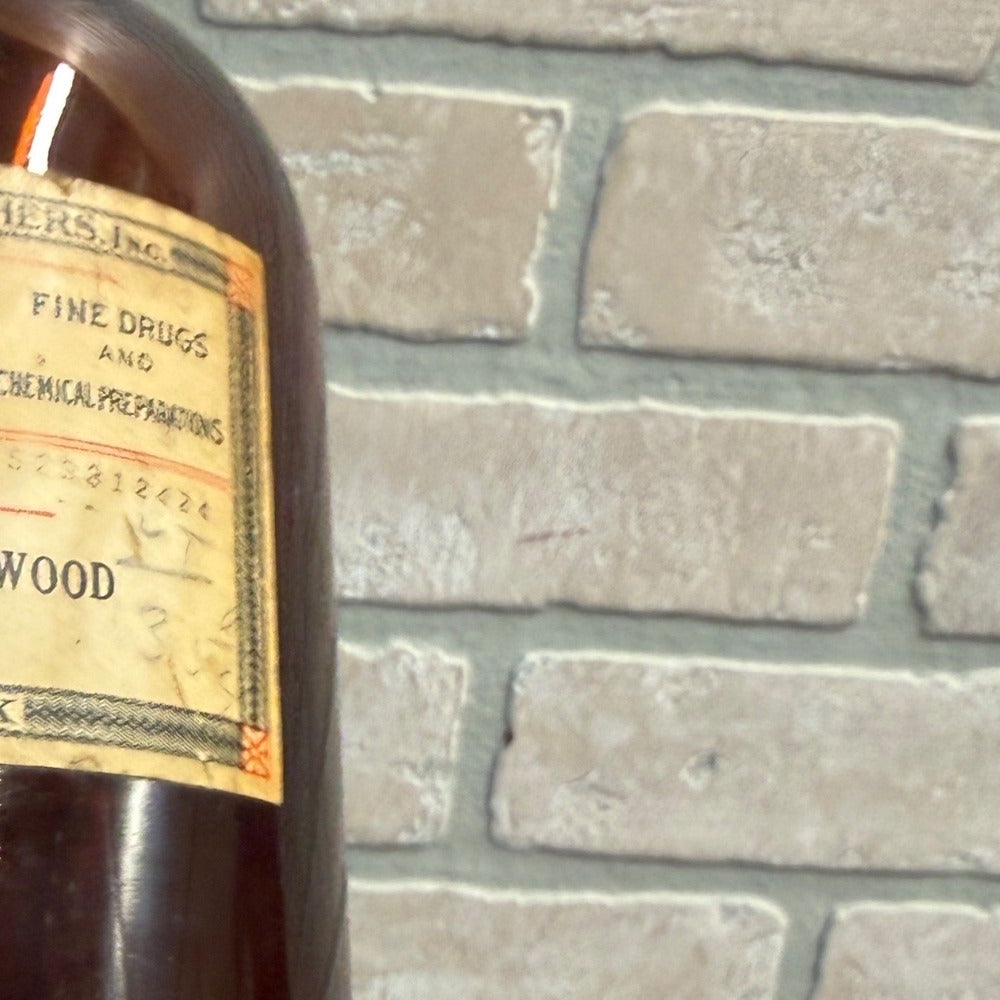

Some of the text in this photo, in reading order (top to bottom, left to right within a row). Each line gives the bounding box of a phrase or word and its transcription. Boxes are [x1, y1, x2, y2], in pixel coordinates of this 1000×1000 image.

[32, 291, 209, 359] FINE DRUGS
[98, 344, 153, 374] AND
